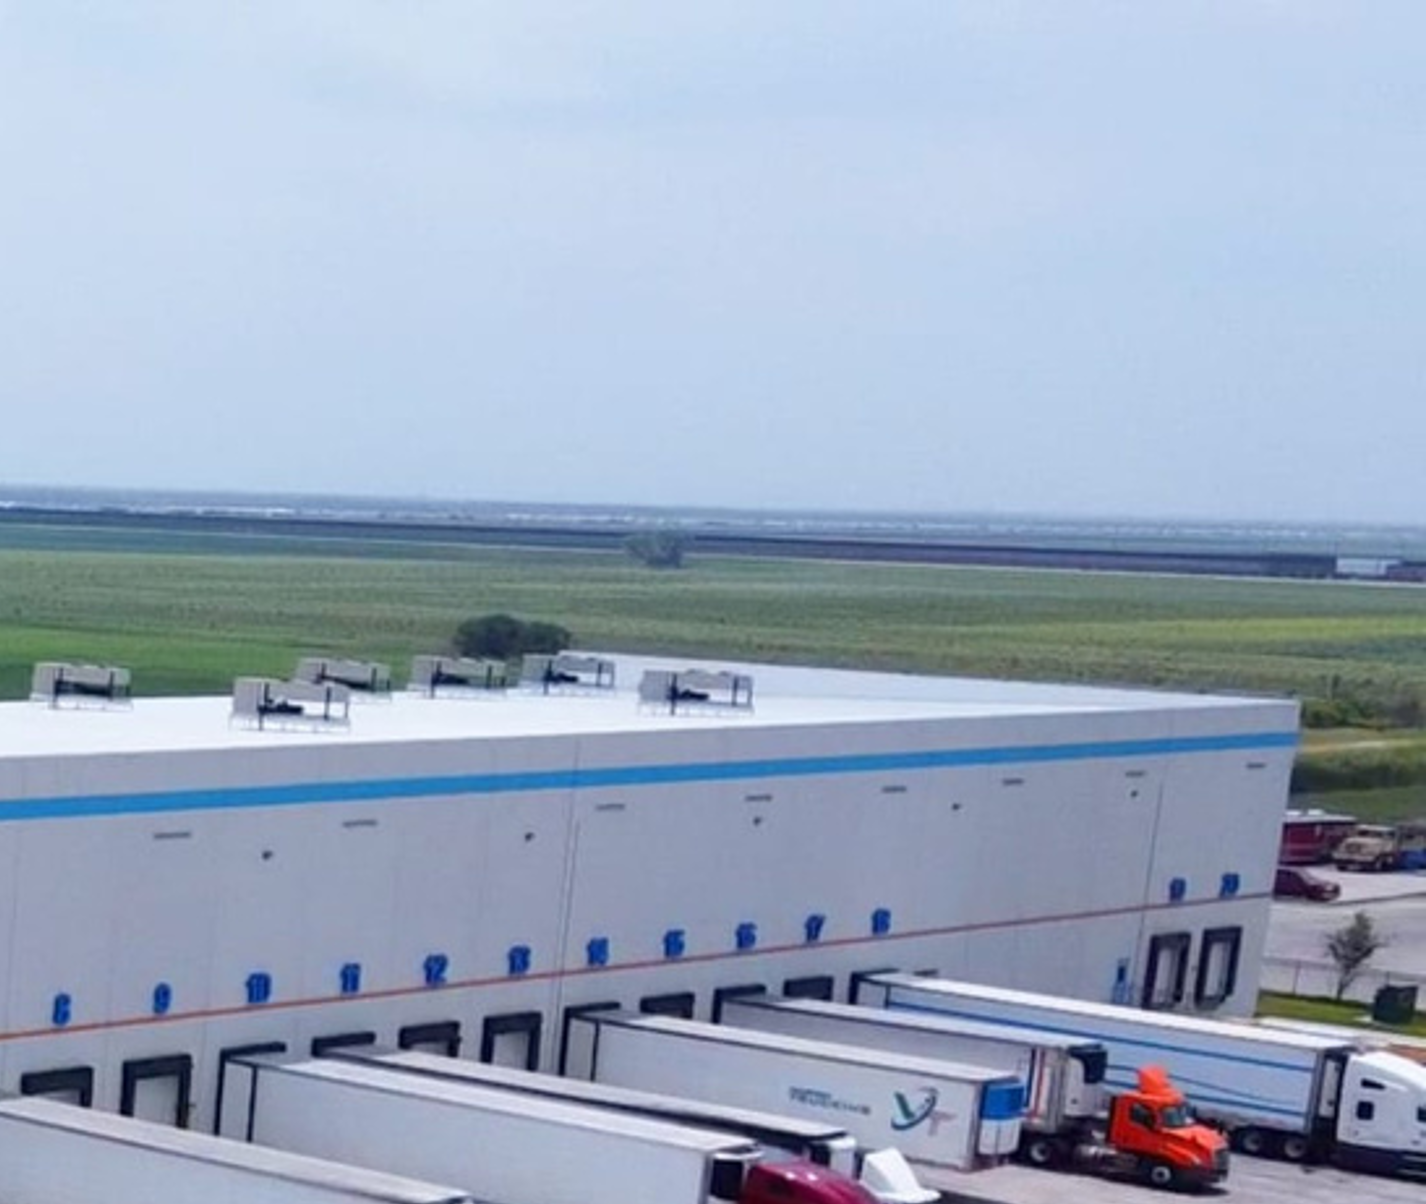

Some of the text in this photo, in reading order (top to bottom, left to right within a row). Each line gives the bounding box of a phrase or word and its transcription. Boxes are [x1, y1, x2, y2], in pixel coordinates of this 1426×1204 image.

[339, 963, 361, 994] 11
[422, 954, 449, 986] 12
[152, 983, 172, 1014] 9
[244, 972, 272, 1003] 10
[51, 993, 72, 1026] 8
